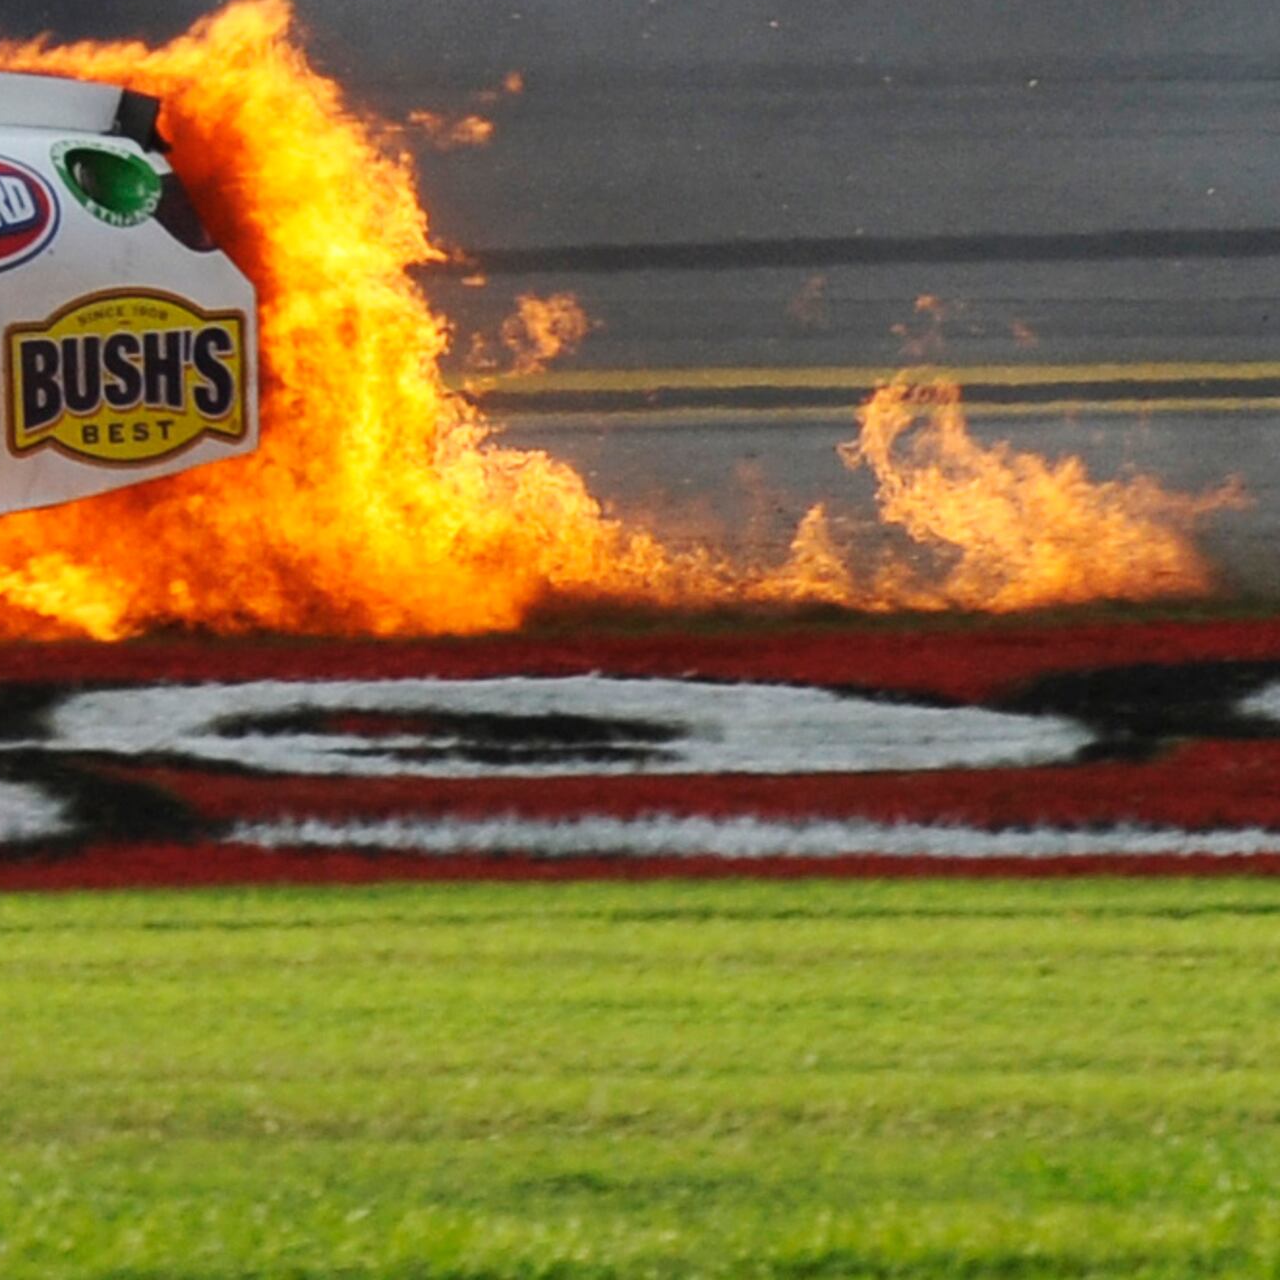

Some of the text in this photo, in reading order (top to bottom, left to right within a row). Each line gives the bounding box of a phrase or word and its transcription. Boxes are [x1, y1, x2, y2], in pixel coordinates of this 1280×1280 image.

[77, 309, 125, 326] SINCE
[20, 325, 235, 432] BUSH'S
[81, 420, 175, 445] BEST
